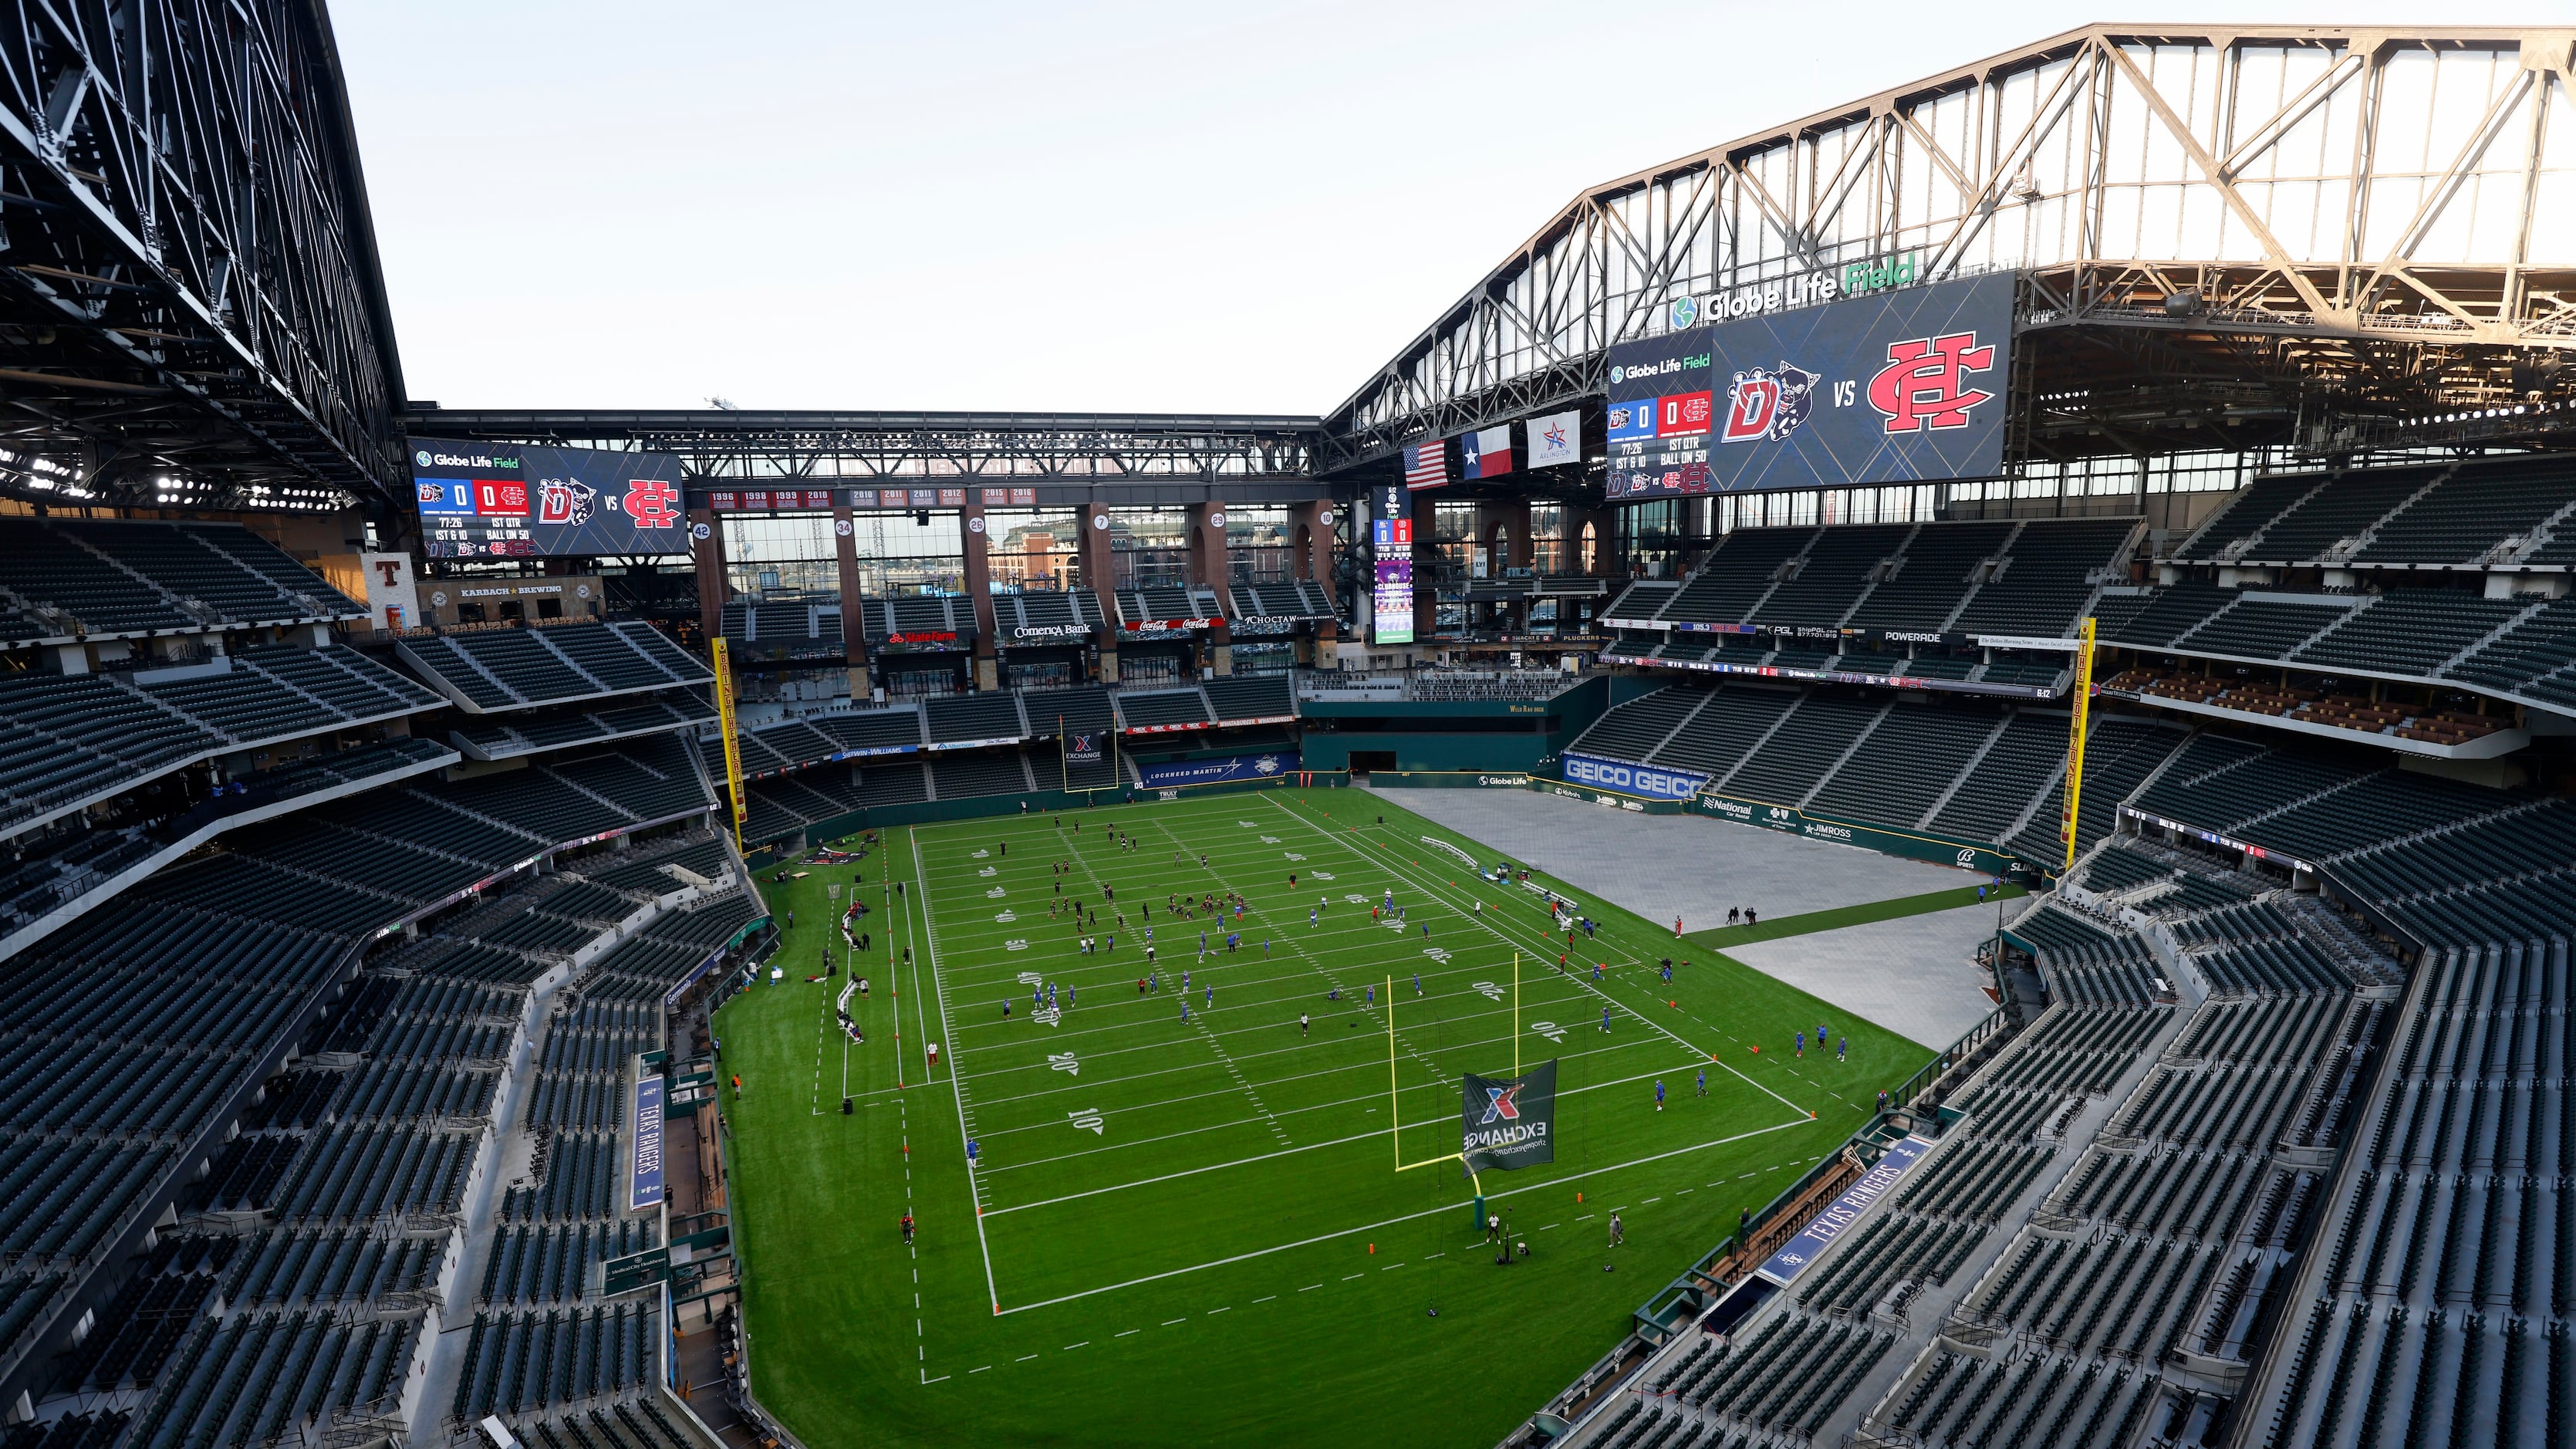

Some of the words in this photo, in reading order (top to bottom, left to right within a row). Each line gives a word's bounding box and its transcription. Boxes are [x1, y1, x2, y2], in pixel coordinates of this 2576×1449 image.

[1706, 289, 1781, 322] Globe
[1787, 272, 1838, 304] Life
[1844, 252, 1915, 295] Field
[1626, 363, 1658, 379] Globe
[1659, 358, 1681, 373] Life
[1683, 353, 1710, 370] Field
[1834, 380, 1856, 408] VS
[1639, 405, 1649, 428] 0
[1666, 402, 1677, 424] 0
[1621, 442, 1642, 455] 77:26
[1669, 438, 1682, 451] 1ST
[1683, 437, 1700, 449] QTR
[1539, 449, 1571, 460] ARLINGTON
[1660, 453, 1680, 466] BALL
[1681, 451, 1693, 464] ON
[1695, 450, 1707, 463] 50
[434, 454, 469, 467] Globe
[470, 455, 492, 468] Life
[493, 457, 519, 469] Field
[1616, 457, 1629, 469] 1ST
[1638, 455, 1646, 468] 10
[454, 485, 468, 506] 0
[482, 485, 495, 506] 0
[712, 492, 734, 501] 1996
[745, 491, 767, 500] 1998
[775, 491, 797, 499] 1999
[808, 491, 828, 499] 2010
[884, 490, 903, 498] 2011
[913, 489, 932, 498] 2011
[604, 495, 617, 511] VS
[439, 517, 463, 528] 77:26
[491, 518, 505, 528] 1ST
[506, 518, 522, 528] QTR
[1213, 516, 1223, 525] 29
[1323, 514, 1331, 522] 10
[695, 526, 708, 536] 42
[837, 523, 849, 532] 34
[971, 521, 983, 529] 26
[435, 530, 449, 540] 1ST
[458, 530, 468, 540] 10
[486, 529, 505, 540] BALL
[506, 530, 518, 540] ON
[518, 530, 529, 540] 50
[376, 561, 400, 586] T
[461, 588, 510, 597] KARBACH
[518, 585, 562, 595] BREWING
[1250, 615, 1297, 624] CHOCTAW
[1065, 623, 1092, 633] Bank
[1774, 626, 1794, 634] PGL
[1886, 631, 1941, 643] POWERADE
[2078, 643, 2087, 682] THE
[720, 654, 732, 707] BRING
[2037, 689, 2051, 697] 6:12
[727, 708, 736, 739] THE
[1219, 718, 1255, 727] WHATABURGER
[1257, 716, 1293, 724] WHATABURGER
[1065, 751, 1101, 759] EXCHANGE
[731, 740, 741, 783] HEAT
[1150, 771, 1191, 779] LOCKHEED
[1193, 767, 1222, 775] MARTIN
[1566, 759, 1631, 787] GEICO
[1512, 776, 1527, 785] Life
[1562, 789, 1581, 799] Kubota
[1956, 861, 1975, 870] SPORTS
[667, 979, 692, 1005] Germania
[1047, 1052, 1079, 1071] 20
[639, 1104, 660, 1133] TEXAS
[1068, 1108, 1103, 1129] 10
[638, 1133, 659, 1175] RANGERS
[1804, 1205, 1855, 1243] TEXAS
[1842, 1164, 1902, 1209] RANGERS
[611, 1266, 630, 1275] Medical
[640, 1257, 667, 1267] Healthcare
